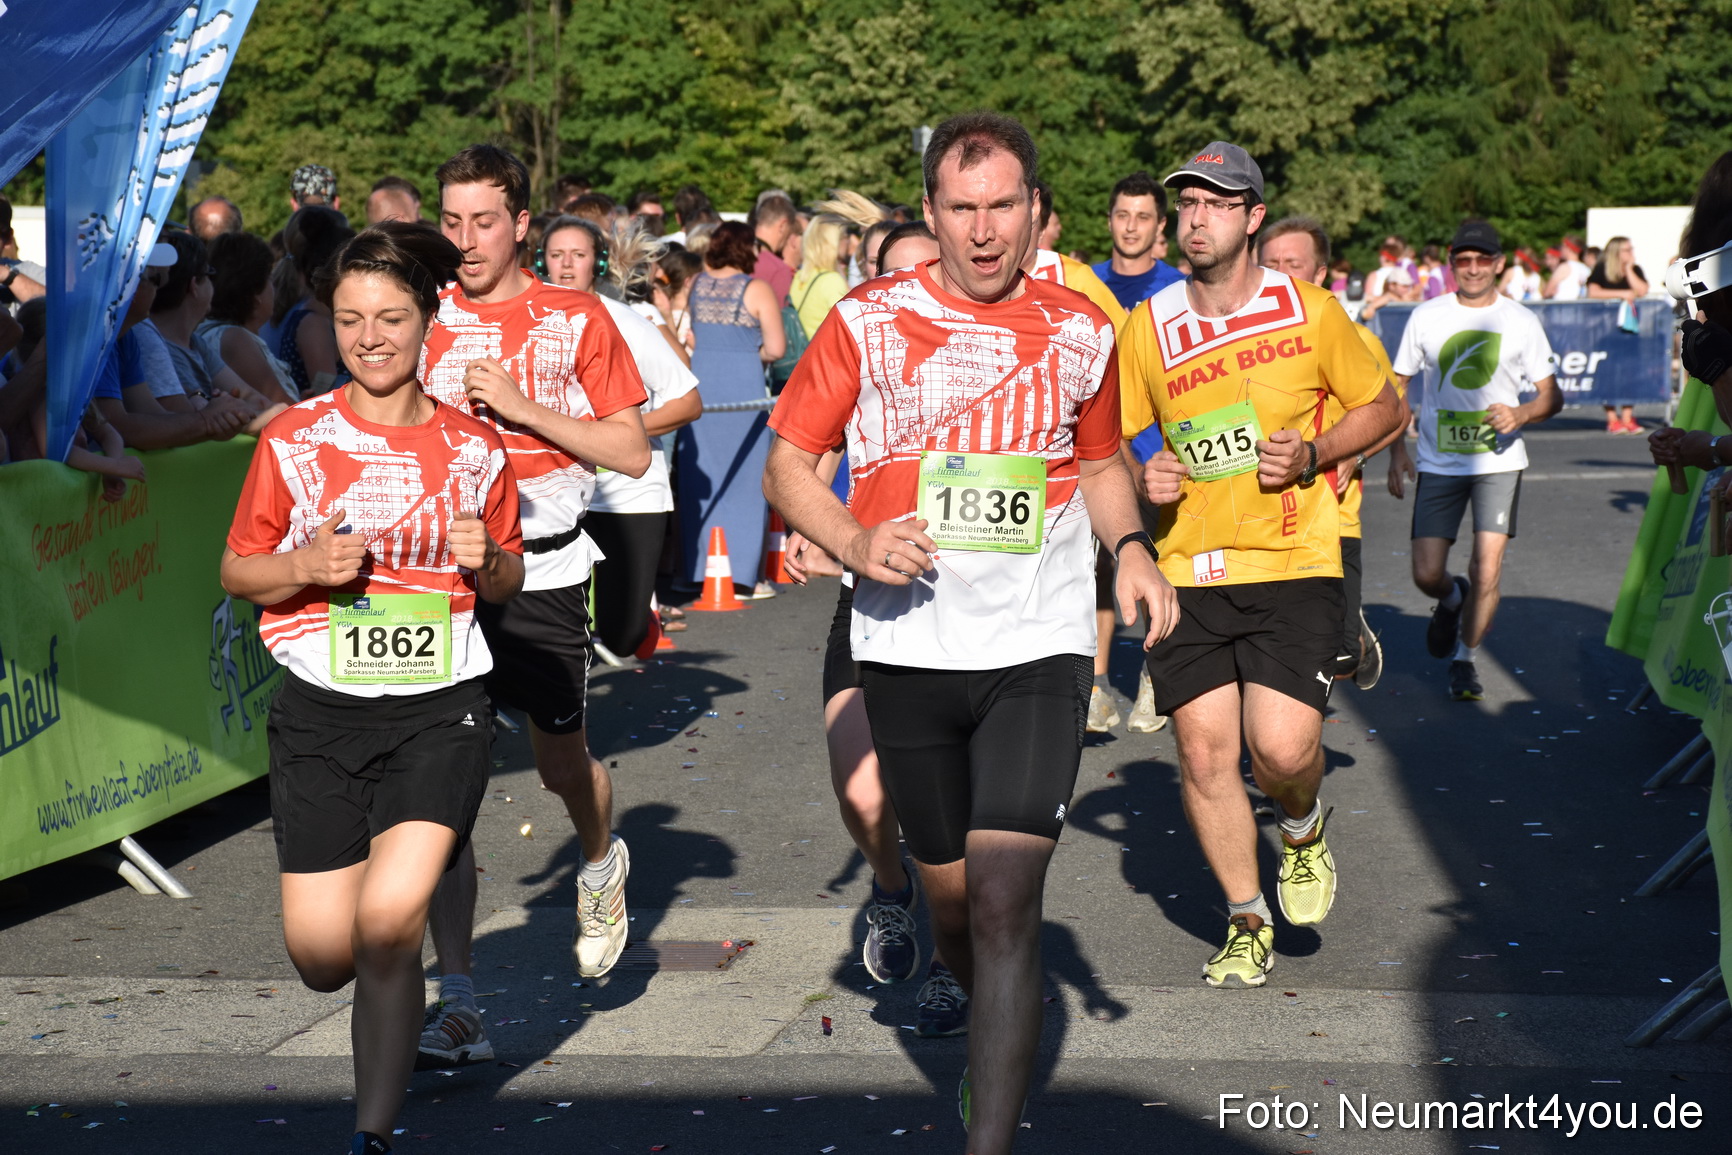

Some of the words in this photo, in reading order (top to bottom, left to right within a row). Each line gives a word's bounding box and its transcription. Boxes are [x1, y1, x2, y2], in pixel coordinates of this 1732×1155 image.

[1194, 153, 1224, 165] FILA
[1166, 357, 1230, 400] MAX
[1235, 335, 1312, 371] BÖGL
[946, 374, 984, 388] 26.22
[355, 444, 387, 454] 10.54
[1183, 426, 1252, 465] 1215
[1192, 462, 1220, 472] Gebhard
[1221, 452, 1255, 467] Johannes
[937, 467, 982, 478] firmenlauf
[357, 493, 391, 503] 52.01
[935, 486, 1031, 526] 1836
[357, 509, 391, 520] 26.22
[31, 499, 95, 572] Gesund
[939, 523, 993, 534] Bleisteiner
[994, 526, 1024, 536] Martin
[931, 532, 967, 541] Sparkasse
[968, 534, 1029, 545] Neumarkt-Parsberg
[108, 520, 162, 601] länger!
[345, 608, 387, 617] firmenlauf
[345, 626, 435, 658] 1862
[346, 660, 393, 668] Schneider
[395, 659, 435, 668] Johanna
[343, 668, 376, 676] Sparkasse
[377, 668, 437, 676] Neumarkt-Parsberg
